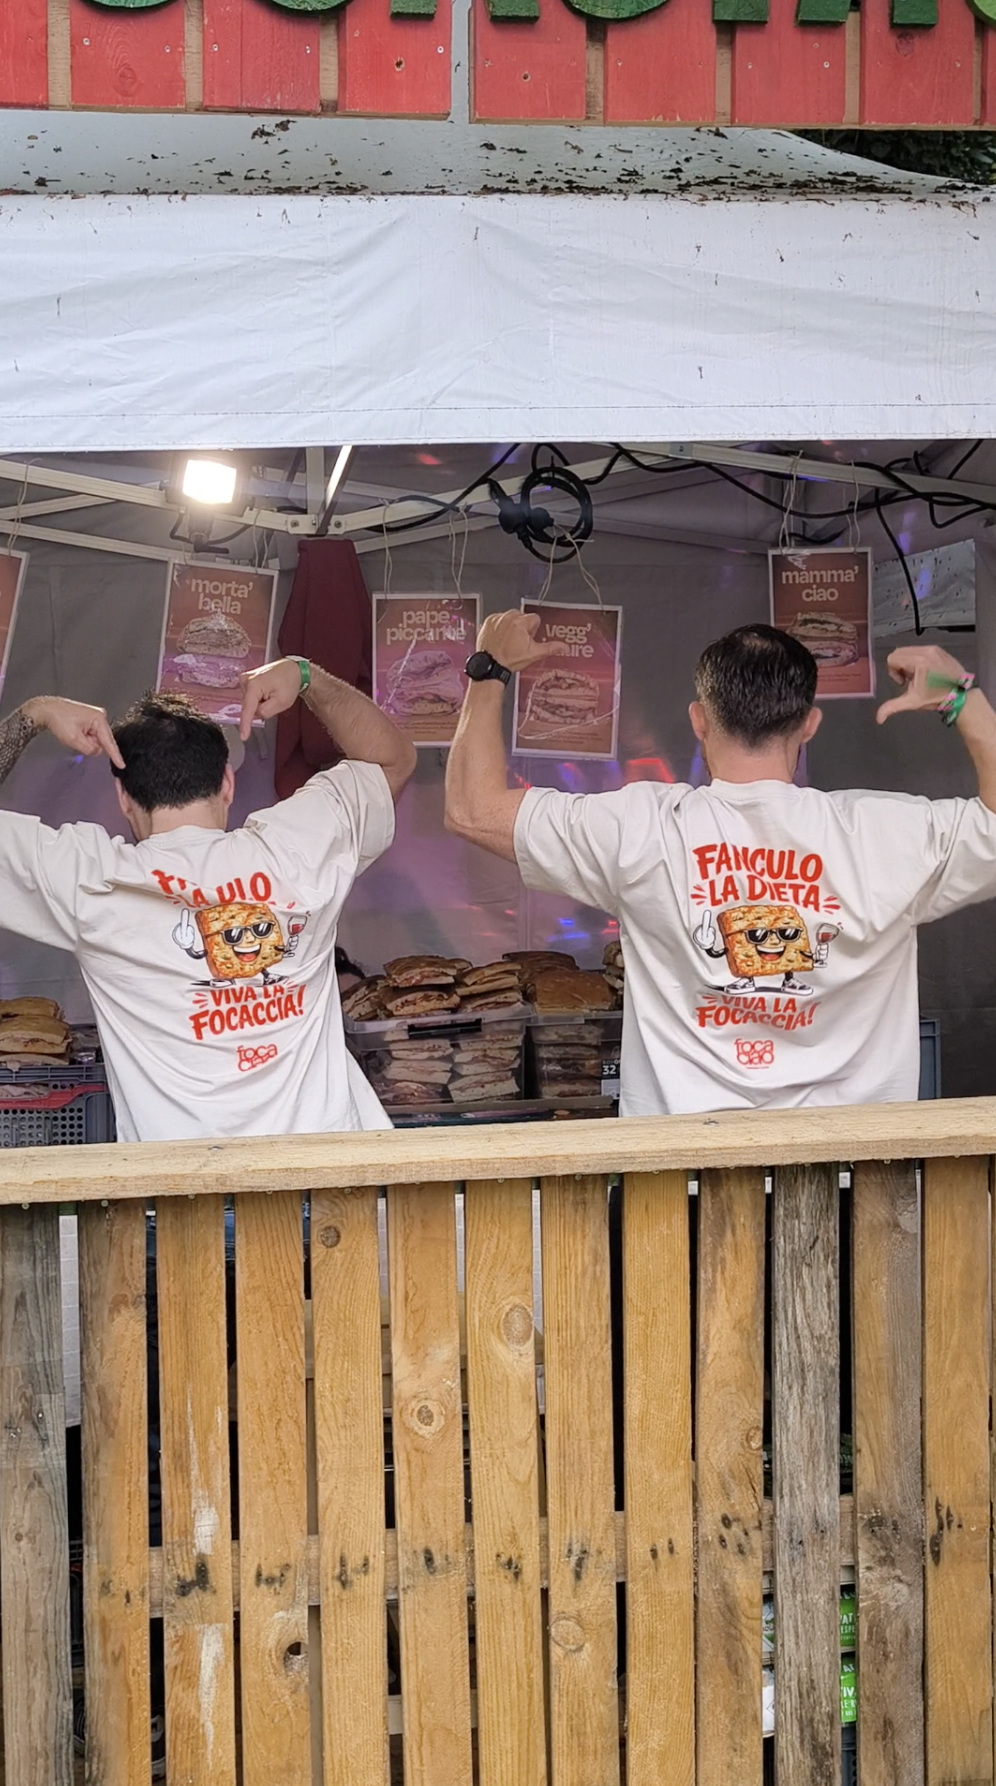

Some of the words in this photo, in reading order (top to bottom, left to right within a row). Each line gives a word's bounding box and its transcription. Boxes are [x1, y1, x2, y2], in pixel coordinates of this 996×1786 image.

[782, 565, 859, 584] mamma'
[191, 578, 253, 598] morta'
[802, 584, 839, 602] ciao
[198, 593, 241, 614] bella
[403, 610, 450, 628] pape
[692, 842, 823, 882] FANCULO
[708, 875, 740, 907] LA
[746, 874, 821, 913] DIETA
[210, 985, 257, 1007] VIVA
[263, 984, 285, 998] LA
[721, 994, 767, 1012] VIVA
[773, 997, 797, 1013] LA
[189, 984, 307, 1040] FOCACCIA!
[695, 1002, 821, 1031] FOCACCIA!
[236, 1044, 278, 1061] foca
[734, 1038, 774, 1055] foca
[602, 1065, 617, 1075] 32
